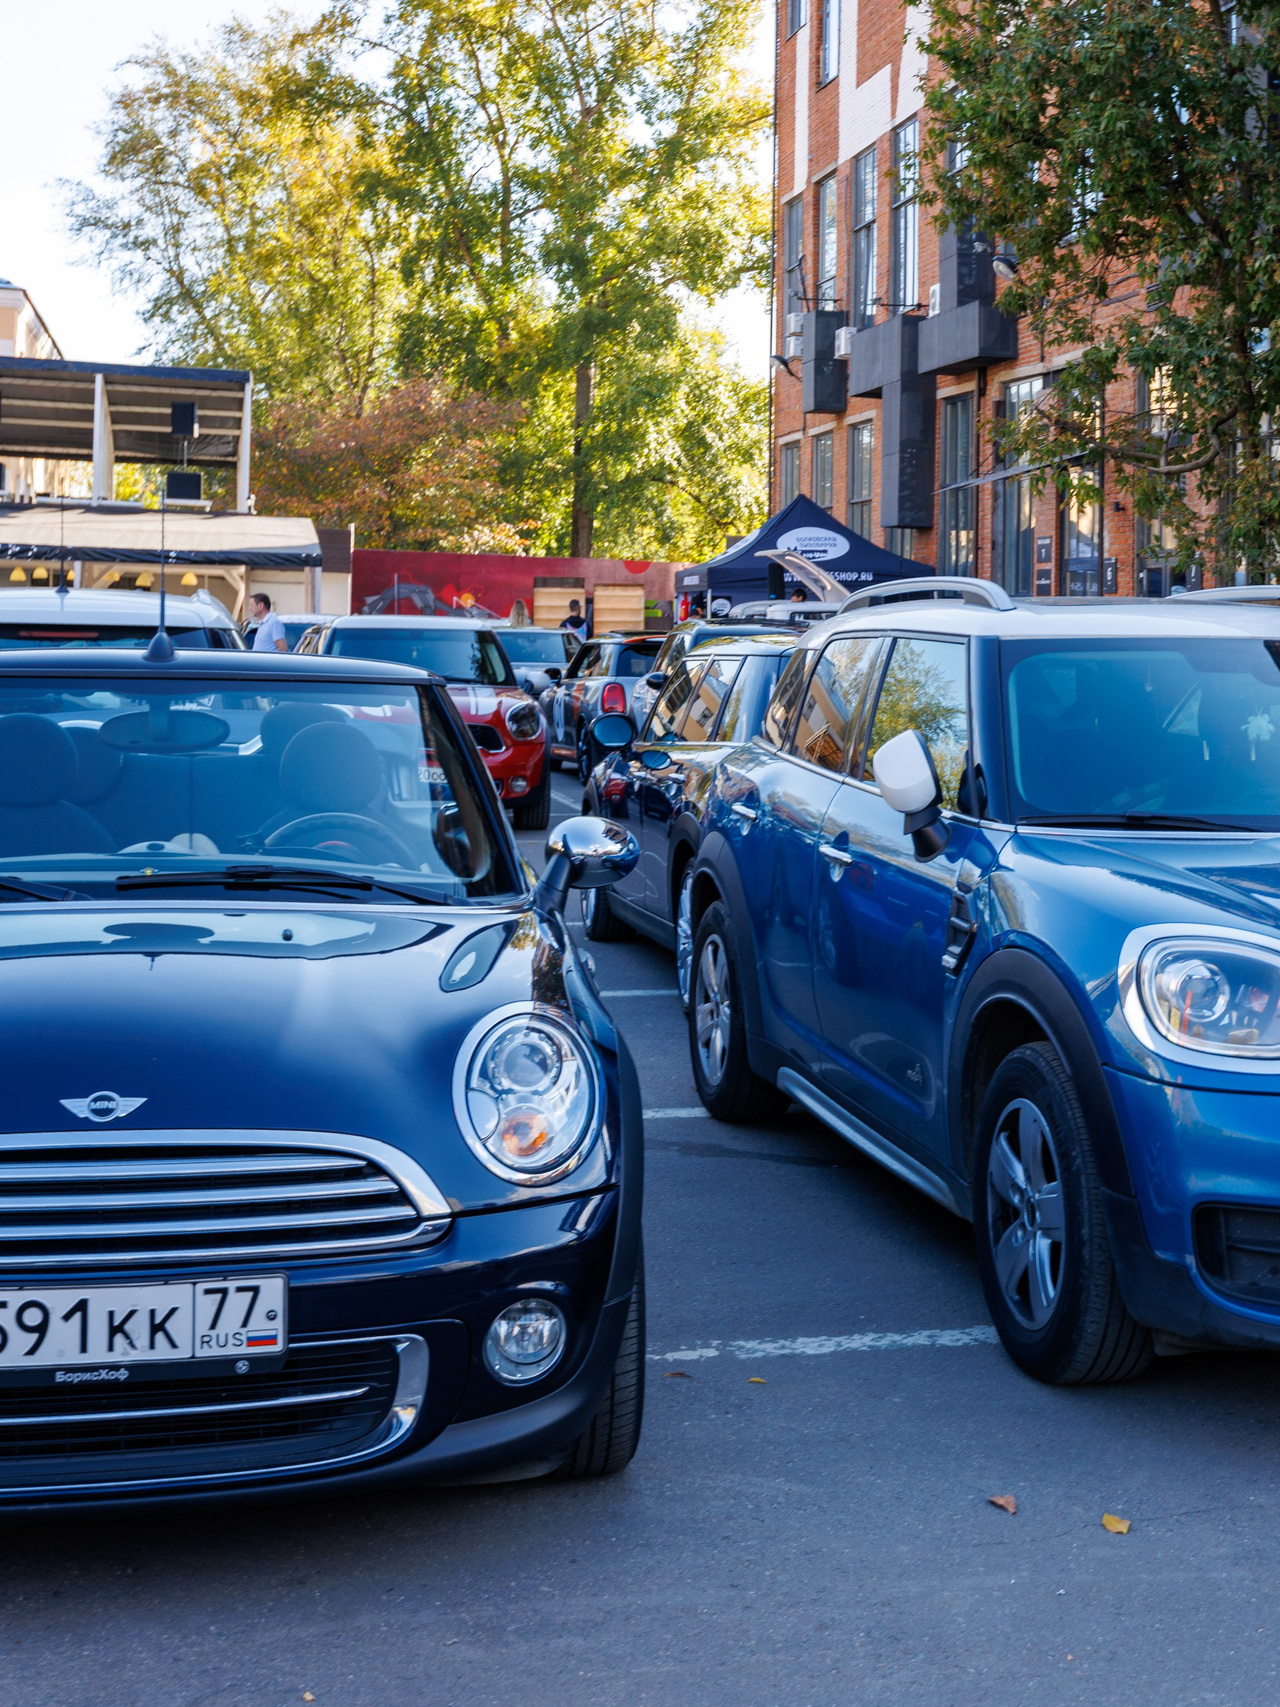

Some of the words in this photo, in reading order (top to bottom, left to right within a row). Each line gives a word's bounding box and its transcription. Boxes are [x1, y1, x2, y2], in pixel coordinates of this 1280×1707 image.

[89, 1099, 118, 1110] MINI
[0, 1297, 181, 1357] 91КК
[203, 1284, 261, 1331] 77
[200, 1331, 244, 1350] RUS
[55, 1367, 129, 1384] БорисХоф
